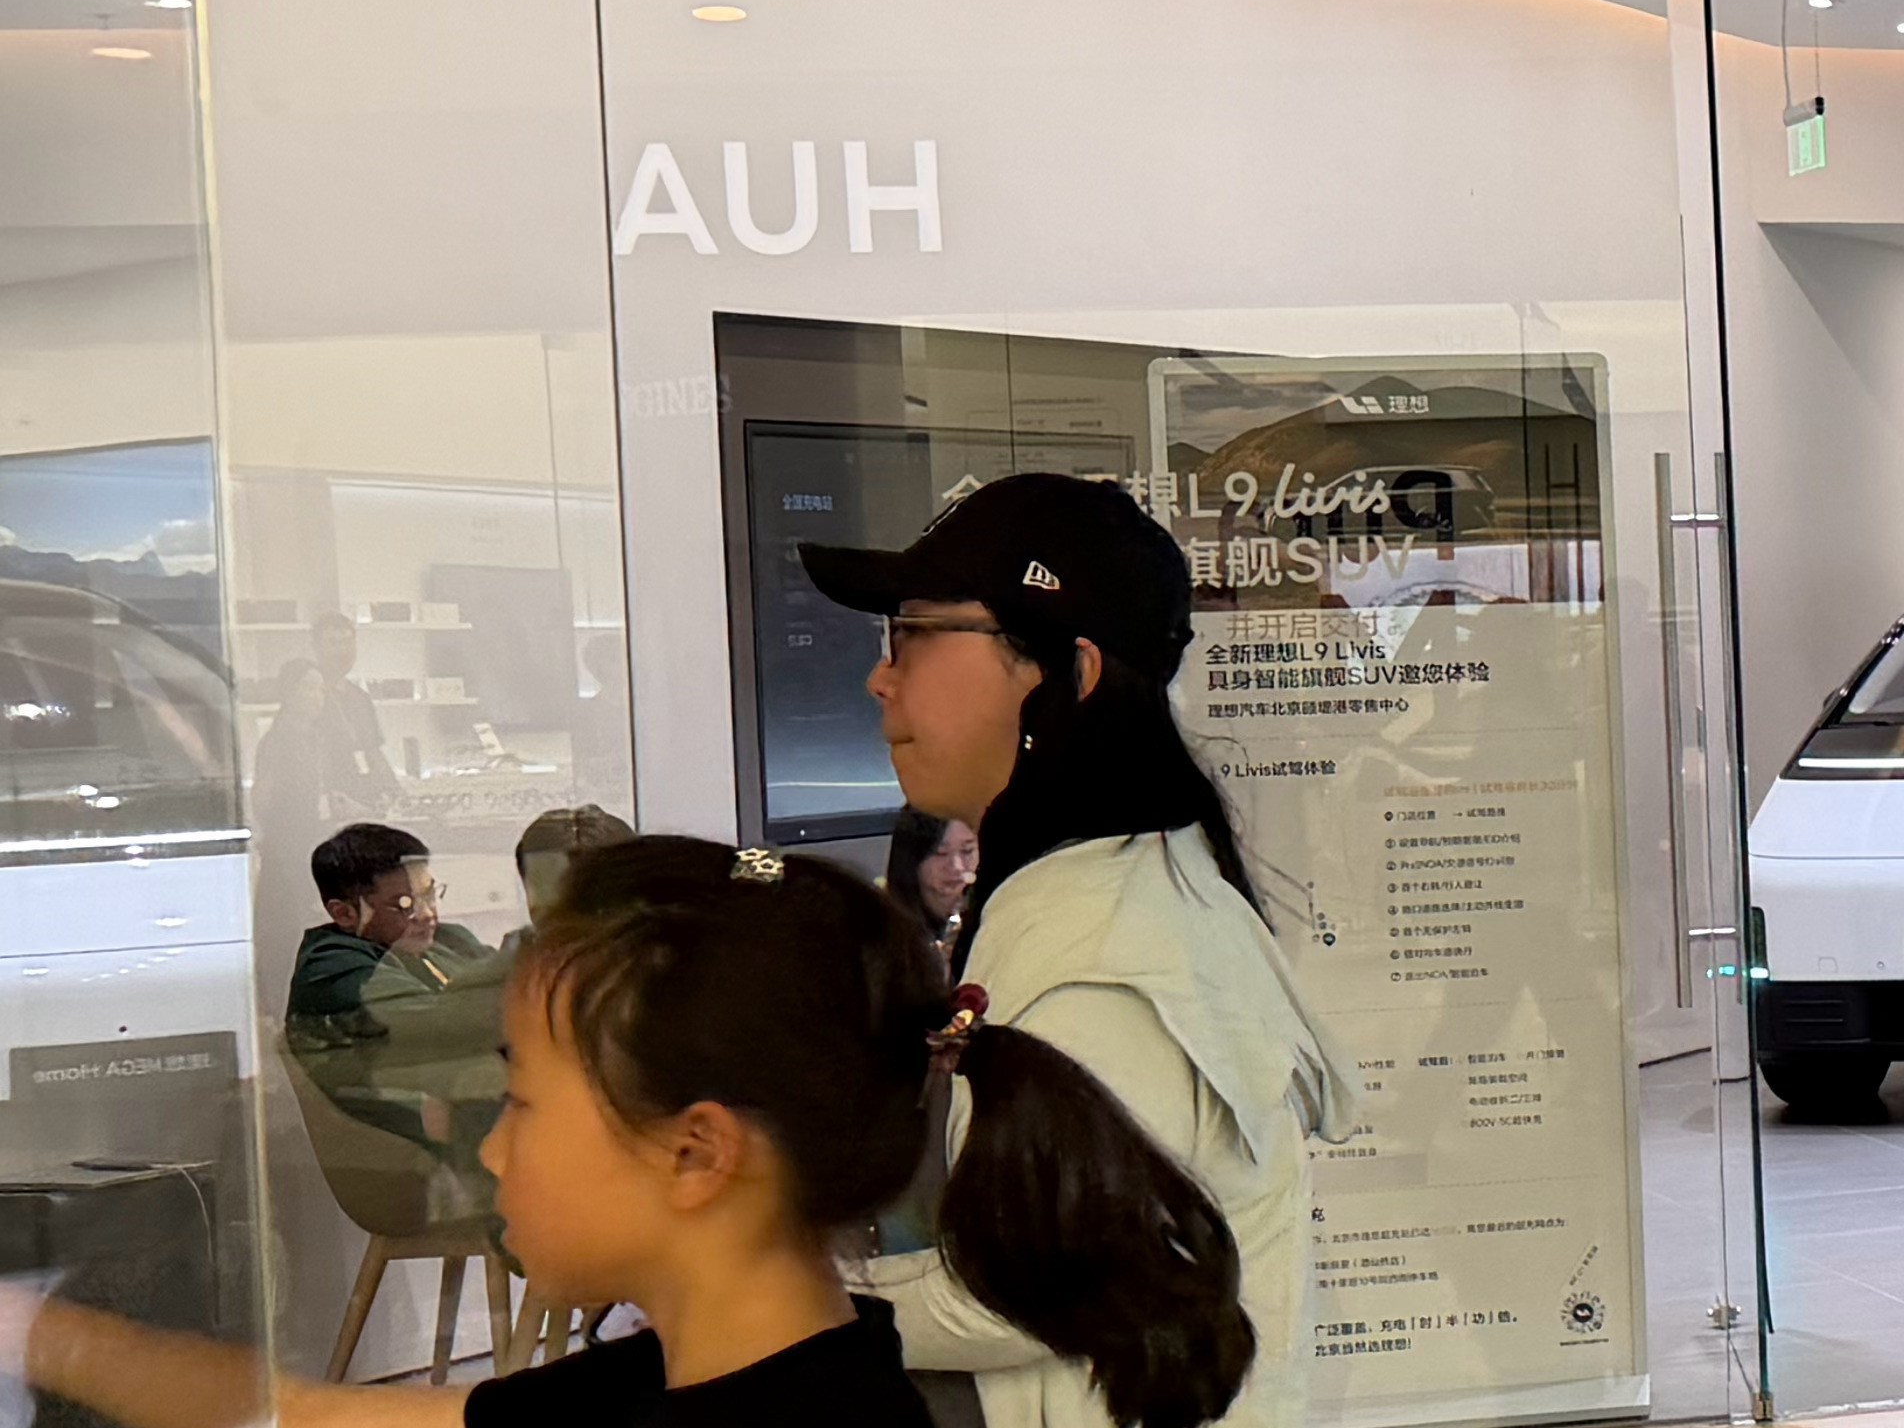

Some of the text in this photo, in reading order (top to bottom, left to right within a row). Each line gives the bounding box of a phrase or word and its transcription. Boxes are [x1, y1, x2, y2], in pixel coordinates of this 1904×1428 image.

[1387, 394, 1430, 414] 理想
[1205, 641, 1329, 666] 全新理想L9
[1207, 660, 1491, 691] 具身智能旗舰SUV邀您体验
